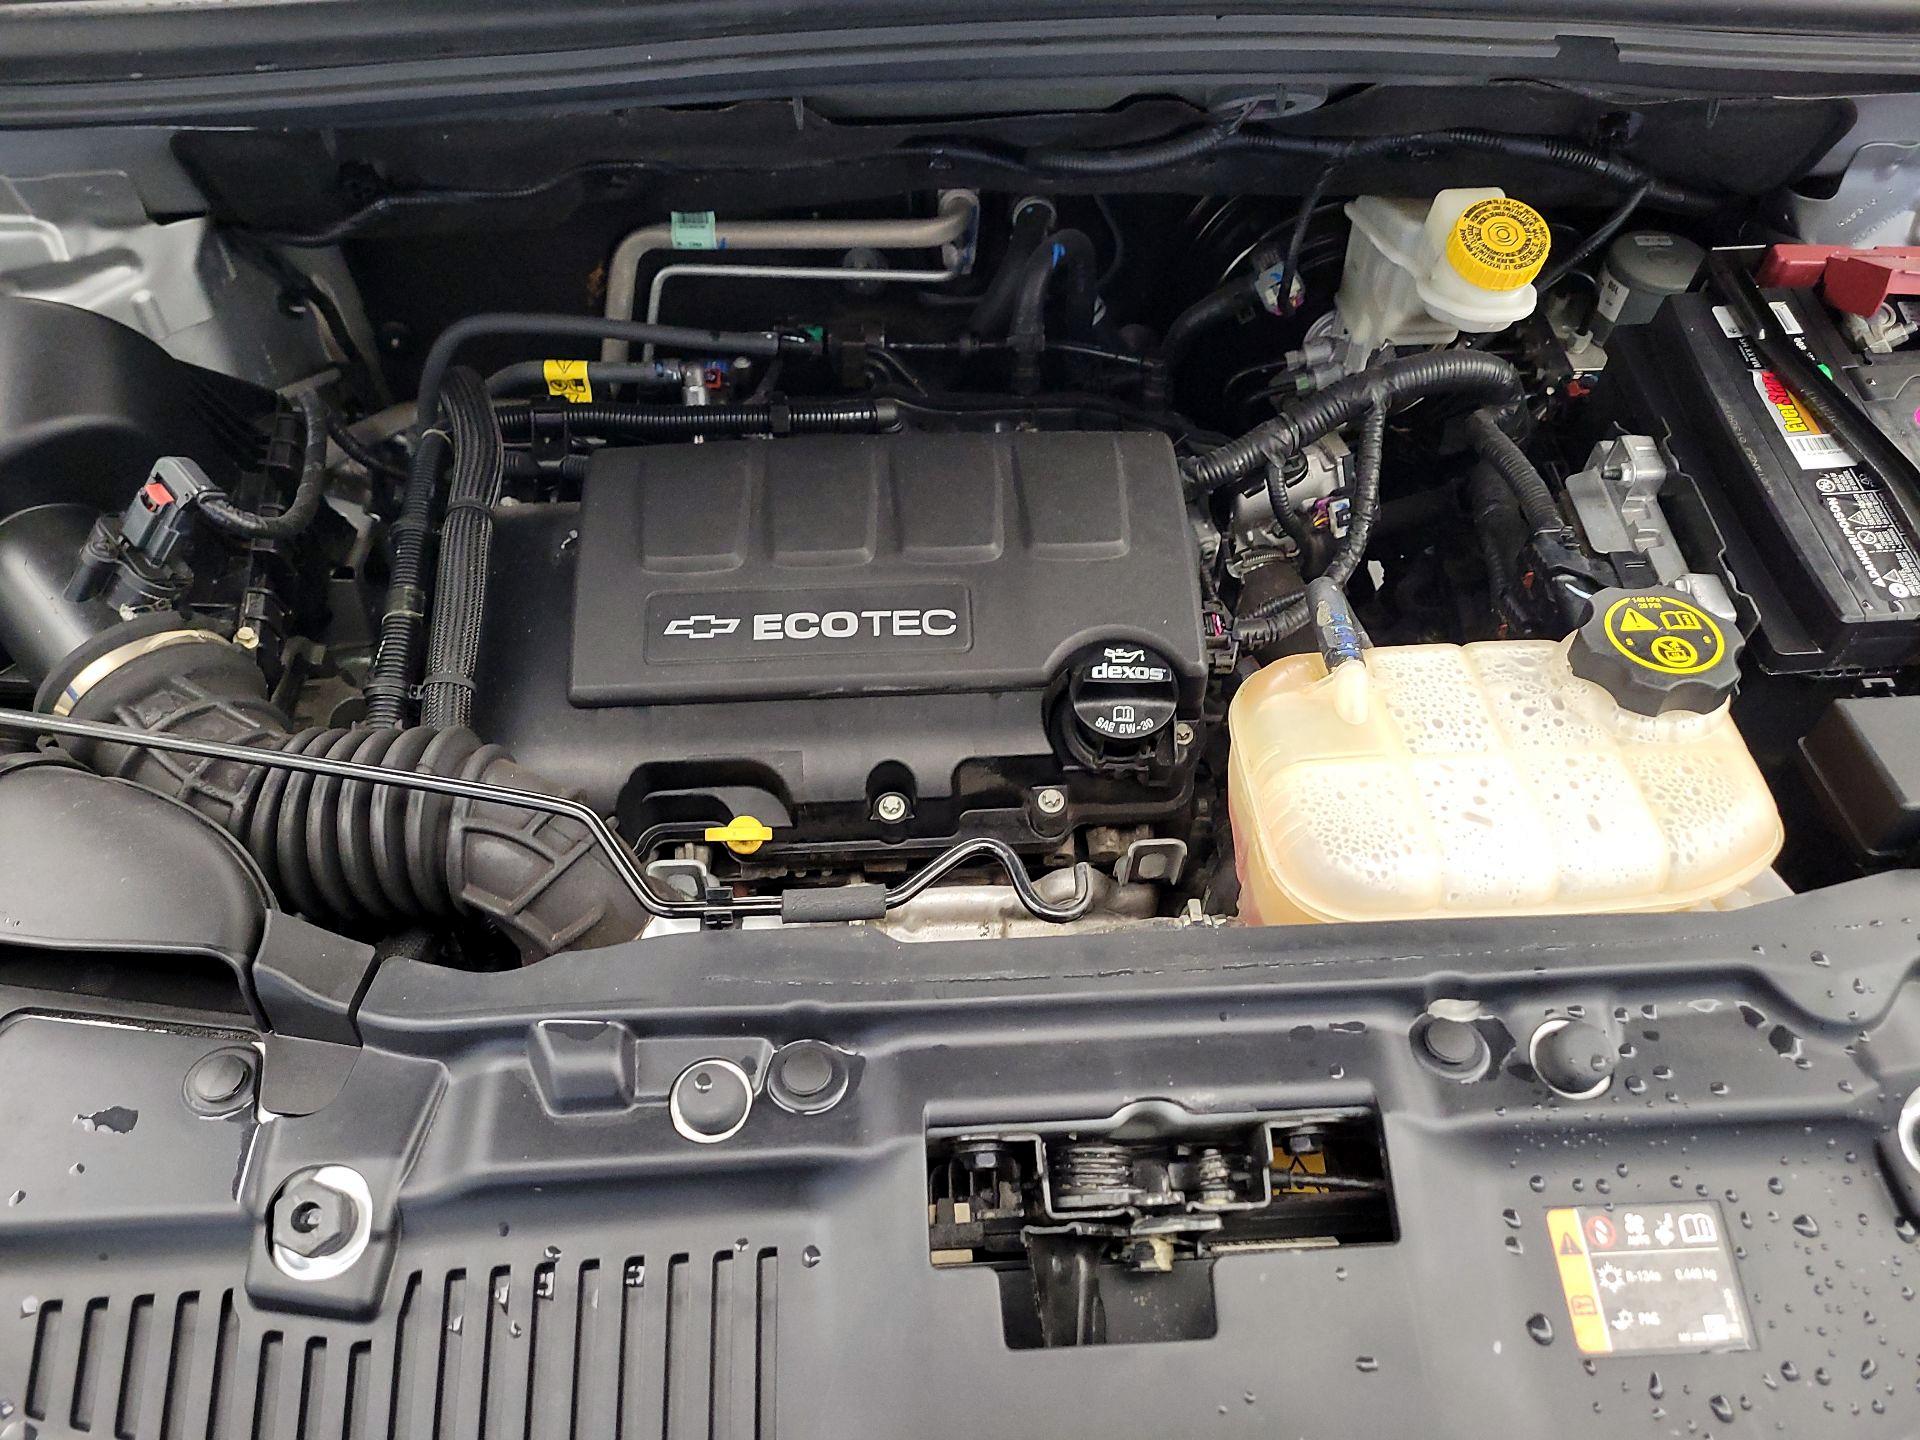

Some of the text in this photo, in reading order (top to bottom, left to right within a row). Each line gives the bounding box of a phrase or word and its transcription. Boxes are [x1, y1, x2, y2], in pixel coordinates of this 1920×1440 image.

[1826, 496, 1880, 578] DANGER/POISON
[753, 609, 957, 640] ECOTEC
[1091, 662, 1165, 680] dexos
[1095, 717, 1115, 733] SAE
